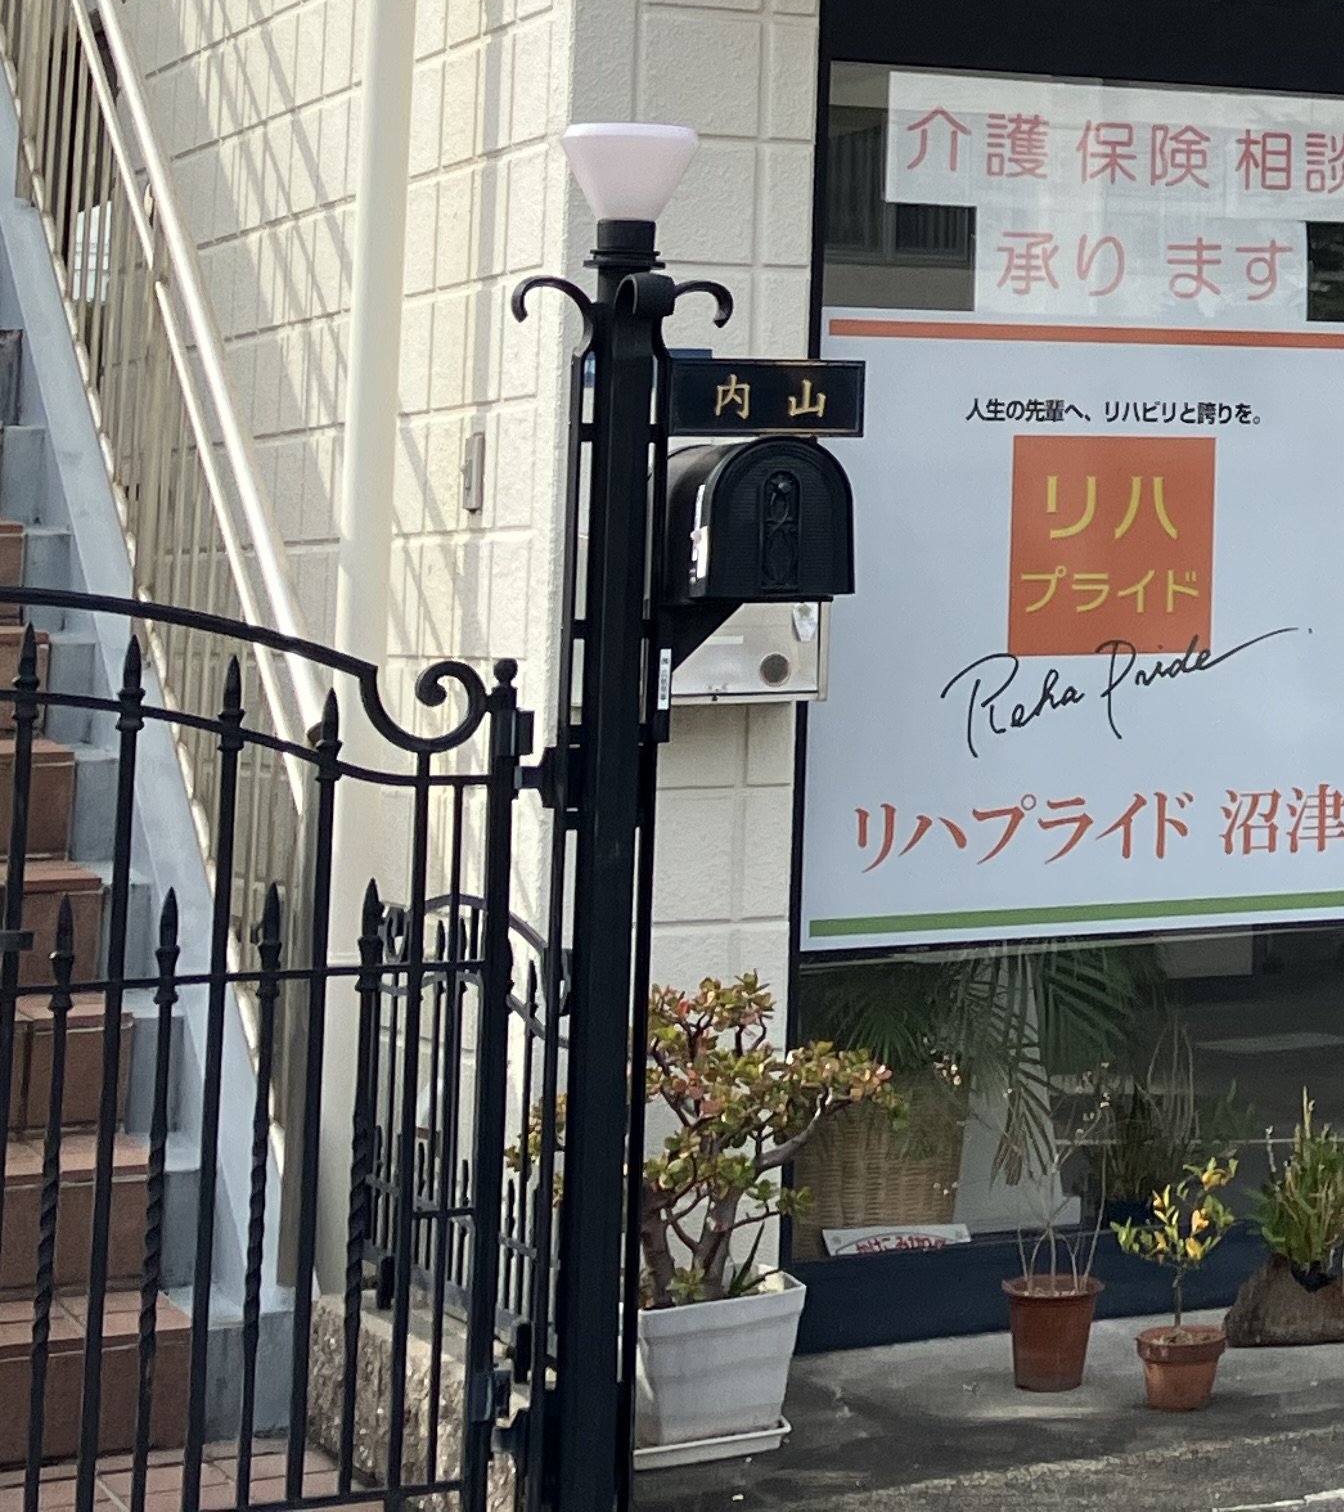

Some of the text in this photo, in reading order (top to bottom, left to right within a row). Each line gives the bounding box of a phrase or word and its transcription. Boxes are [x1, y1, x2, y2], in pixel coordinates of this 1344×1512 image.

[996, 230, 1293, 300] 承ります
[714, 373, 827, 419] 内山
[965, 398, 1262, 425] 人生の先輩へ、リハビリと誇りを。
[1046, 475, 1178, 539] リハ
[1020, 565, 1199, 614] プライド
[941, 628, 1298, 757] Reha Pride
[854, 790, 1193, 872] リハプライド
